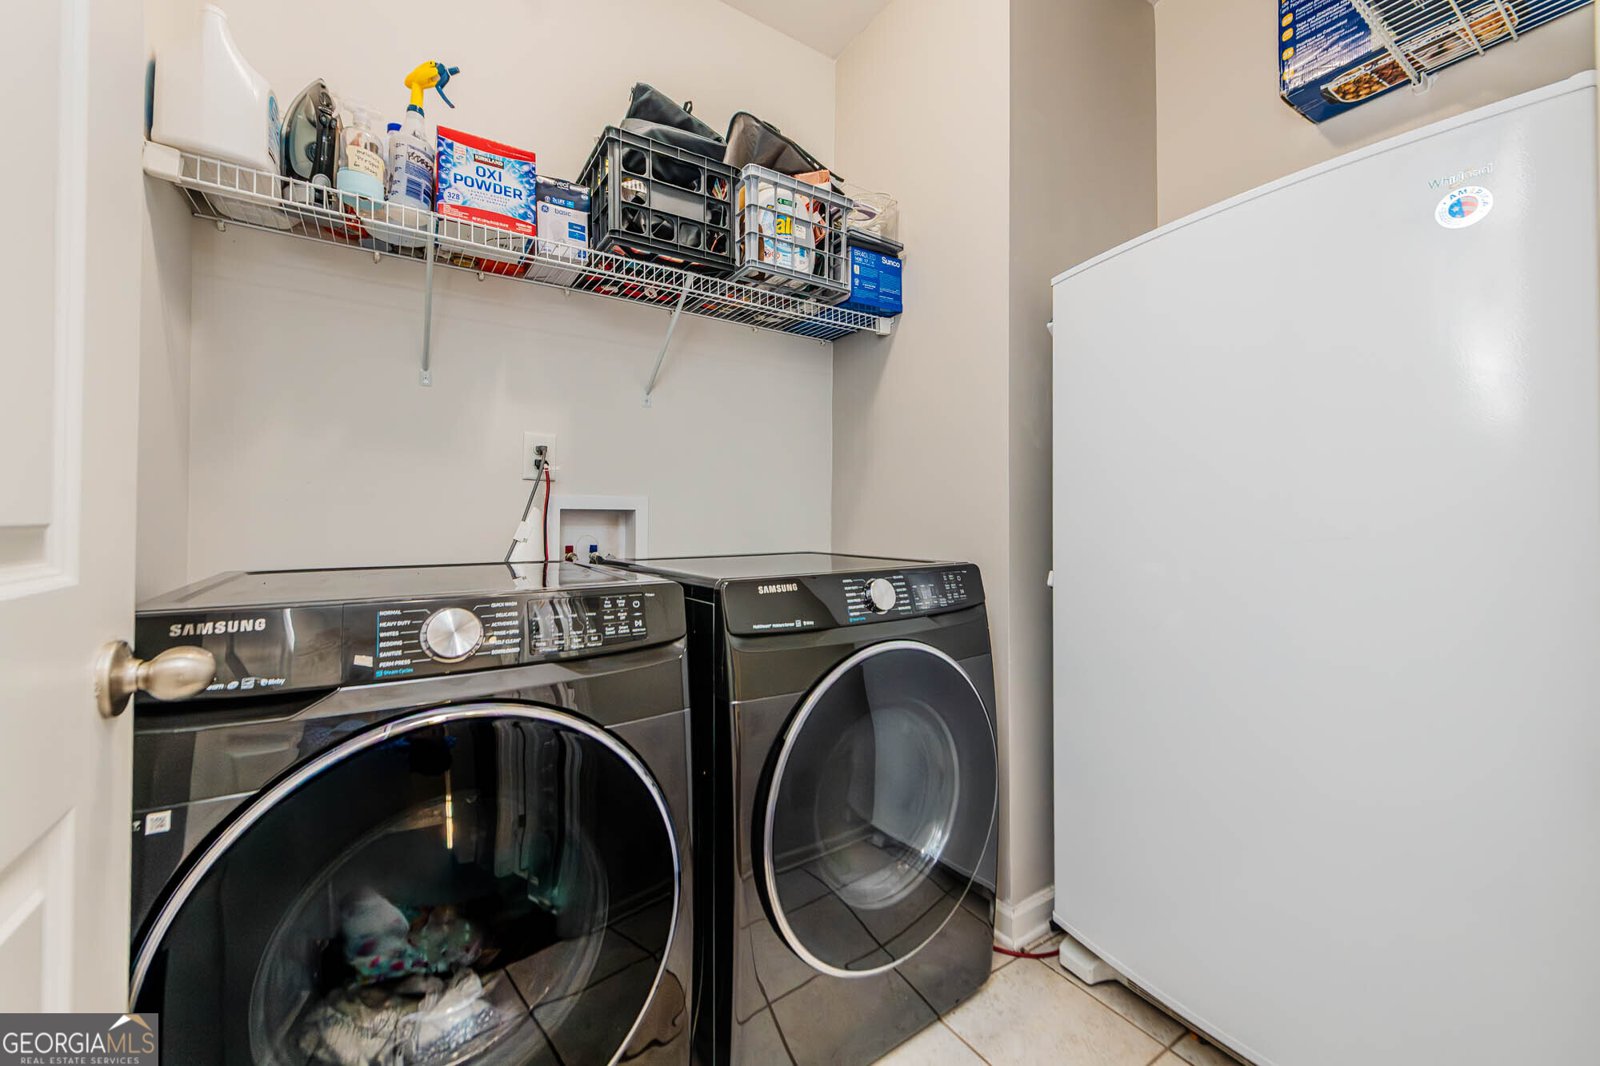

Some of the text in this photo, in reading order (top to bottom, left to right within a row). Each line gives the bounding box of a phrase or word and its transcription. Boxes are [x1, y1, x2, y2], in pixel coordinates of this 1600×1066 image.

[475, 154, 503, 166] KIRKLAND
[475, 165, 502, 182] OXI
[453, 172, 523, 200] POWDER
[447, 191, 460, 200] 328
[555, 208, 572, 217] basic
[882, 256, 900, 268] Sunco
[758, 583, 798, 594] SAMSUNG
[169, 618, 266, 637] SAMSUNG
